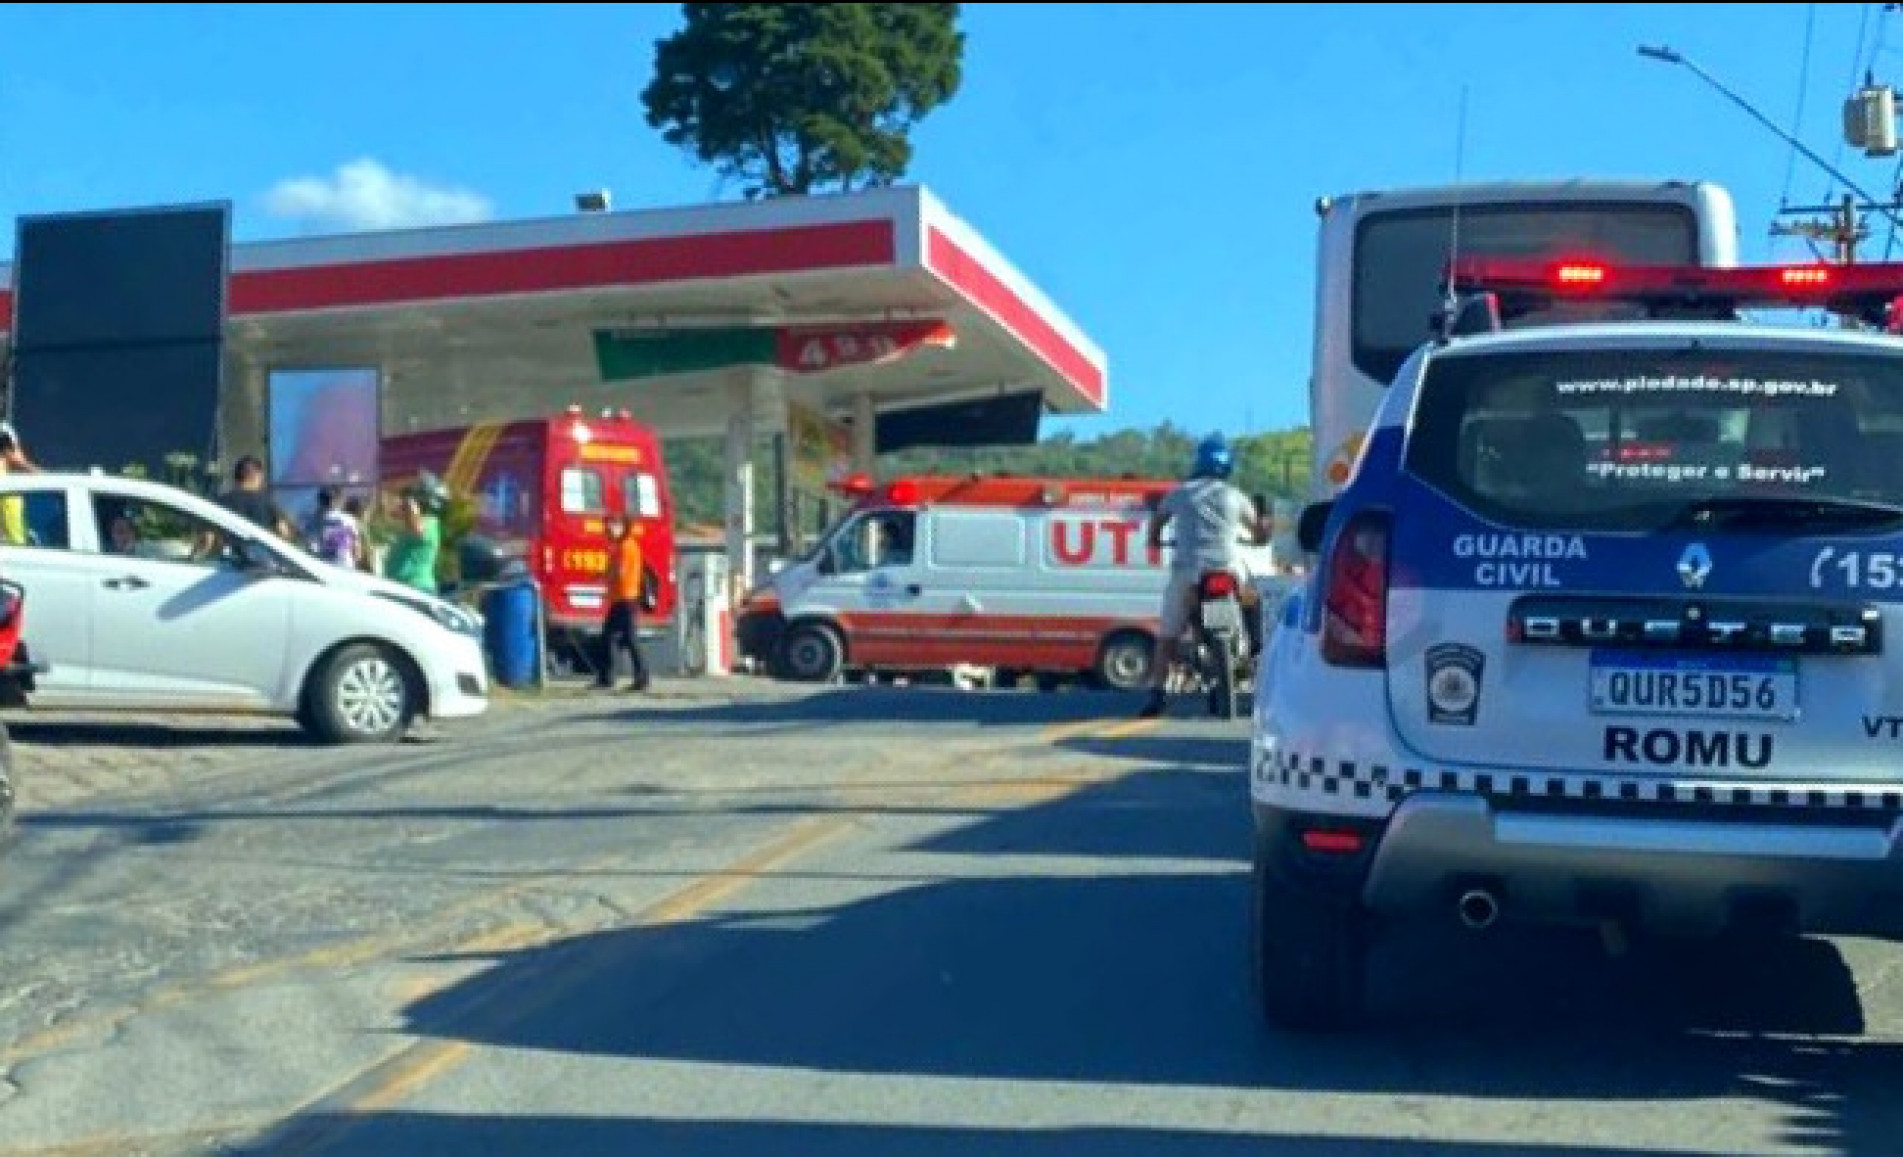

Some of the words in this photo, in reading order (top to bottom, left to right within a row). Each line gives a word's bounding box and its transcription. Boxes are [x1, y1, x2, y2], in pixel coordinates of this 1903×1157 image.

[1452, 533, 1588, 560] GUARDA
[1475, 561, 1561, 586] CIVIL
[1838, 552, 1903, 587] 15
[1609, 671, 1775, 709] QUR5D56
[1604, 726, 1774, 768] ROMU
